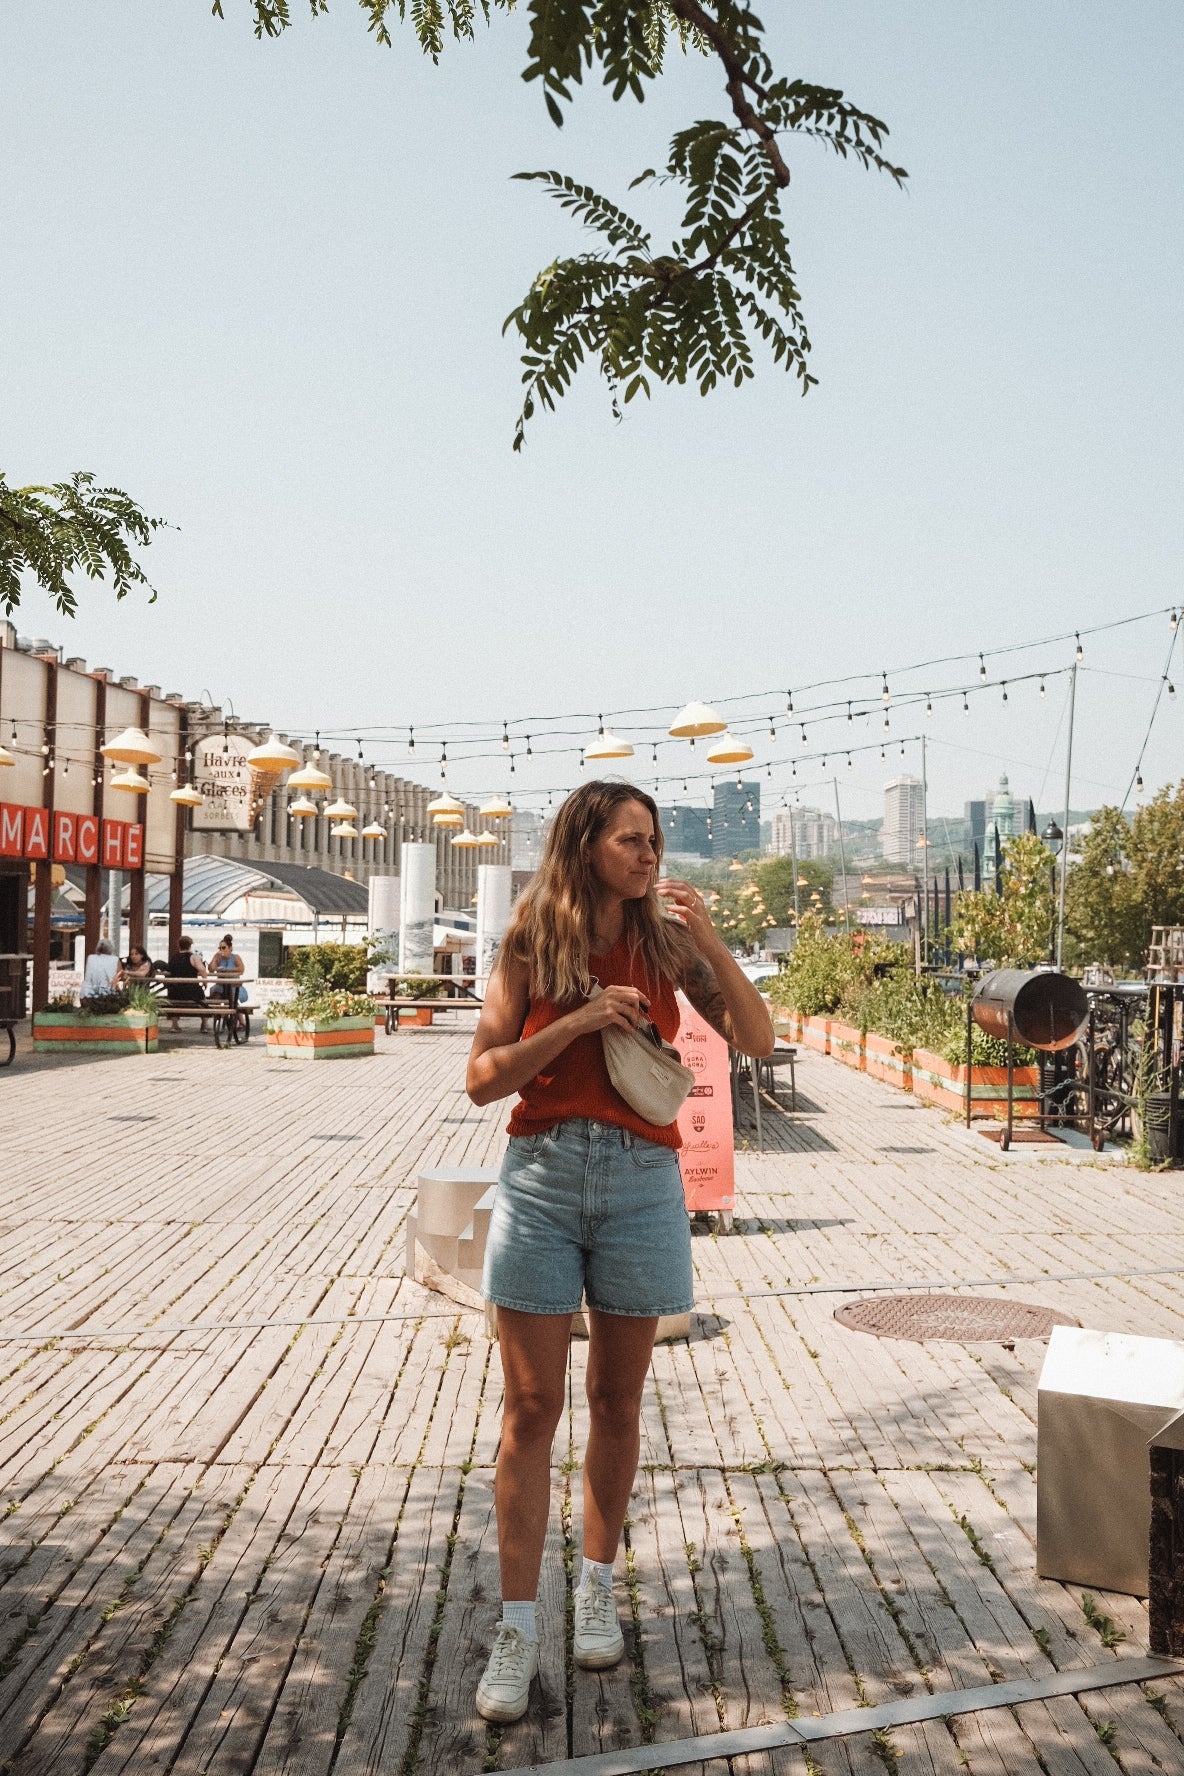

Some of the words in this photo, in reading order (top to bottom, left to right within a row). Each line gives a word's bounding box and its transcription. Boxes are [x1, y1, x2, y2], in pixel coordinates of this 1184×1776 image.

[203, 752, 247, 767] Havre
[213, 770, 235, 779] aux
[200, 782, 247, 797] Glaces
[1, 808, 141, 863] MARCHÉ
[684, 1167, 718, 1175] AYLWIN
